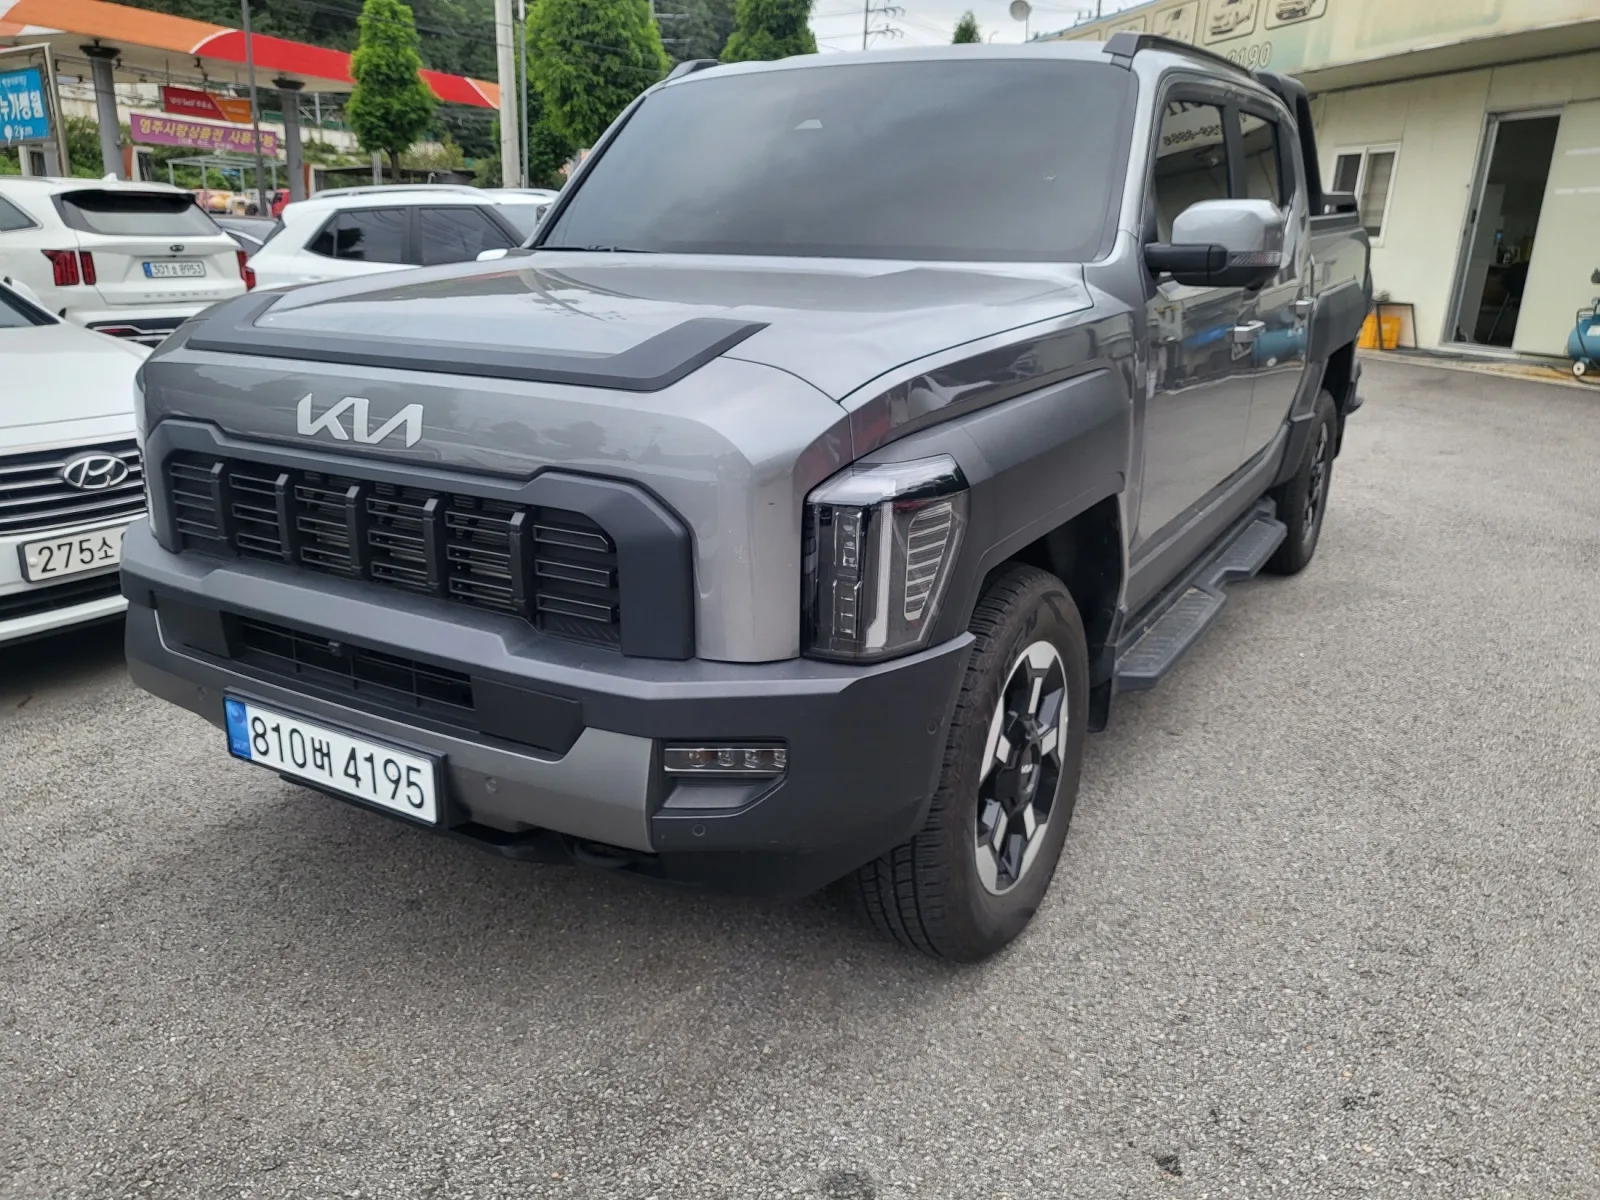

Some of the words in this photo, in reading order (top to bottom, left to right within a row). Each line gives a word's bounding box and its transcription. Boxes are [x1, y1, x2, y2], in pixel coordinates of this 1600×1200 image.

[139, 117, 225, 142] 영주사랑상품권
[296, 392, 424, 448] KIA
[38, 536, 115, 574] 275소
[251, 716, 333, 778] 810버
[343, 747, 425, 809] 4195
